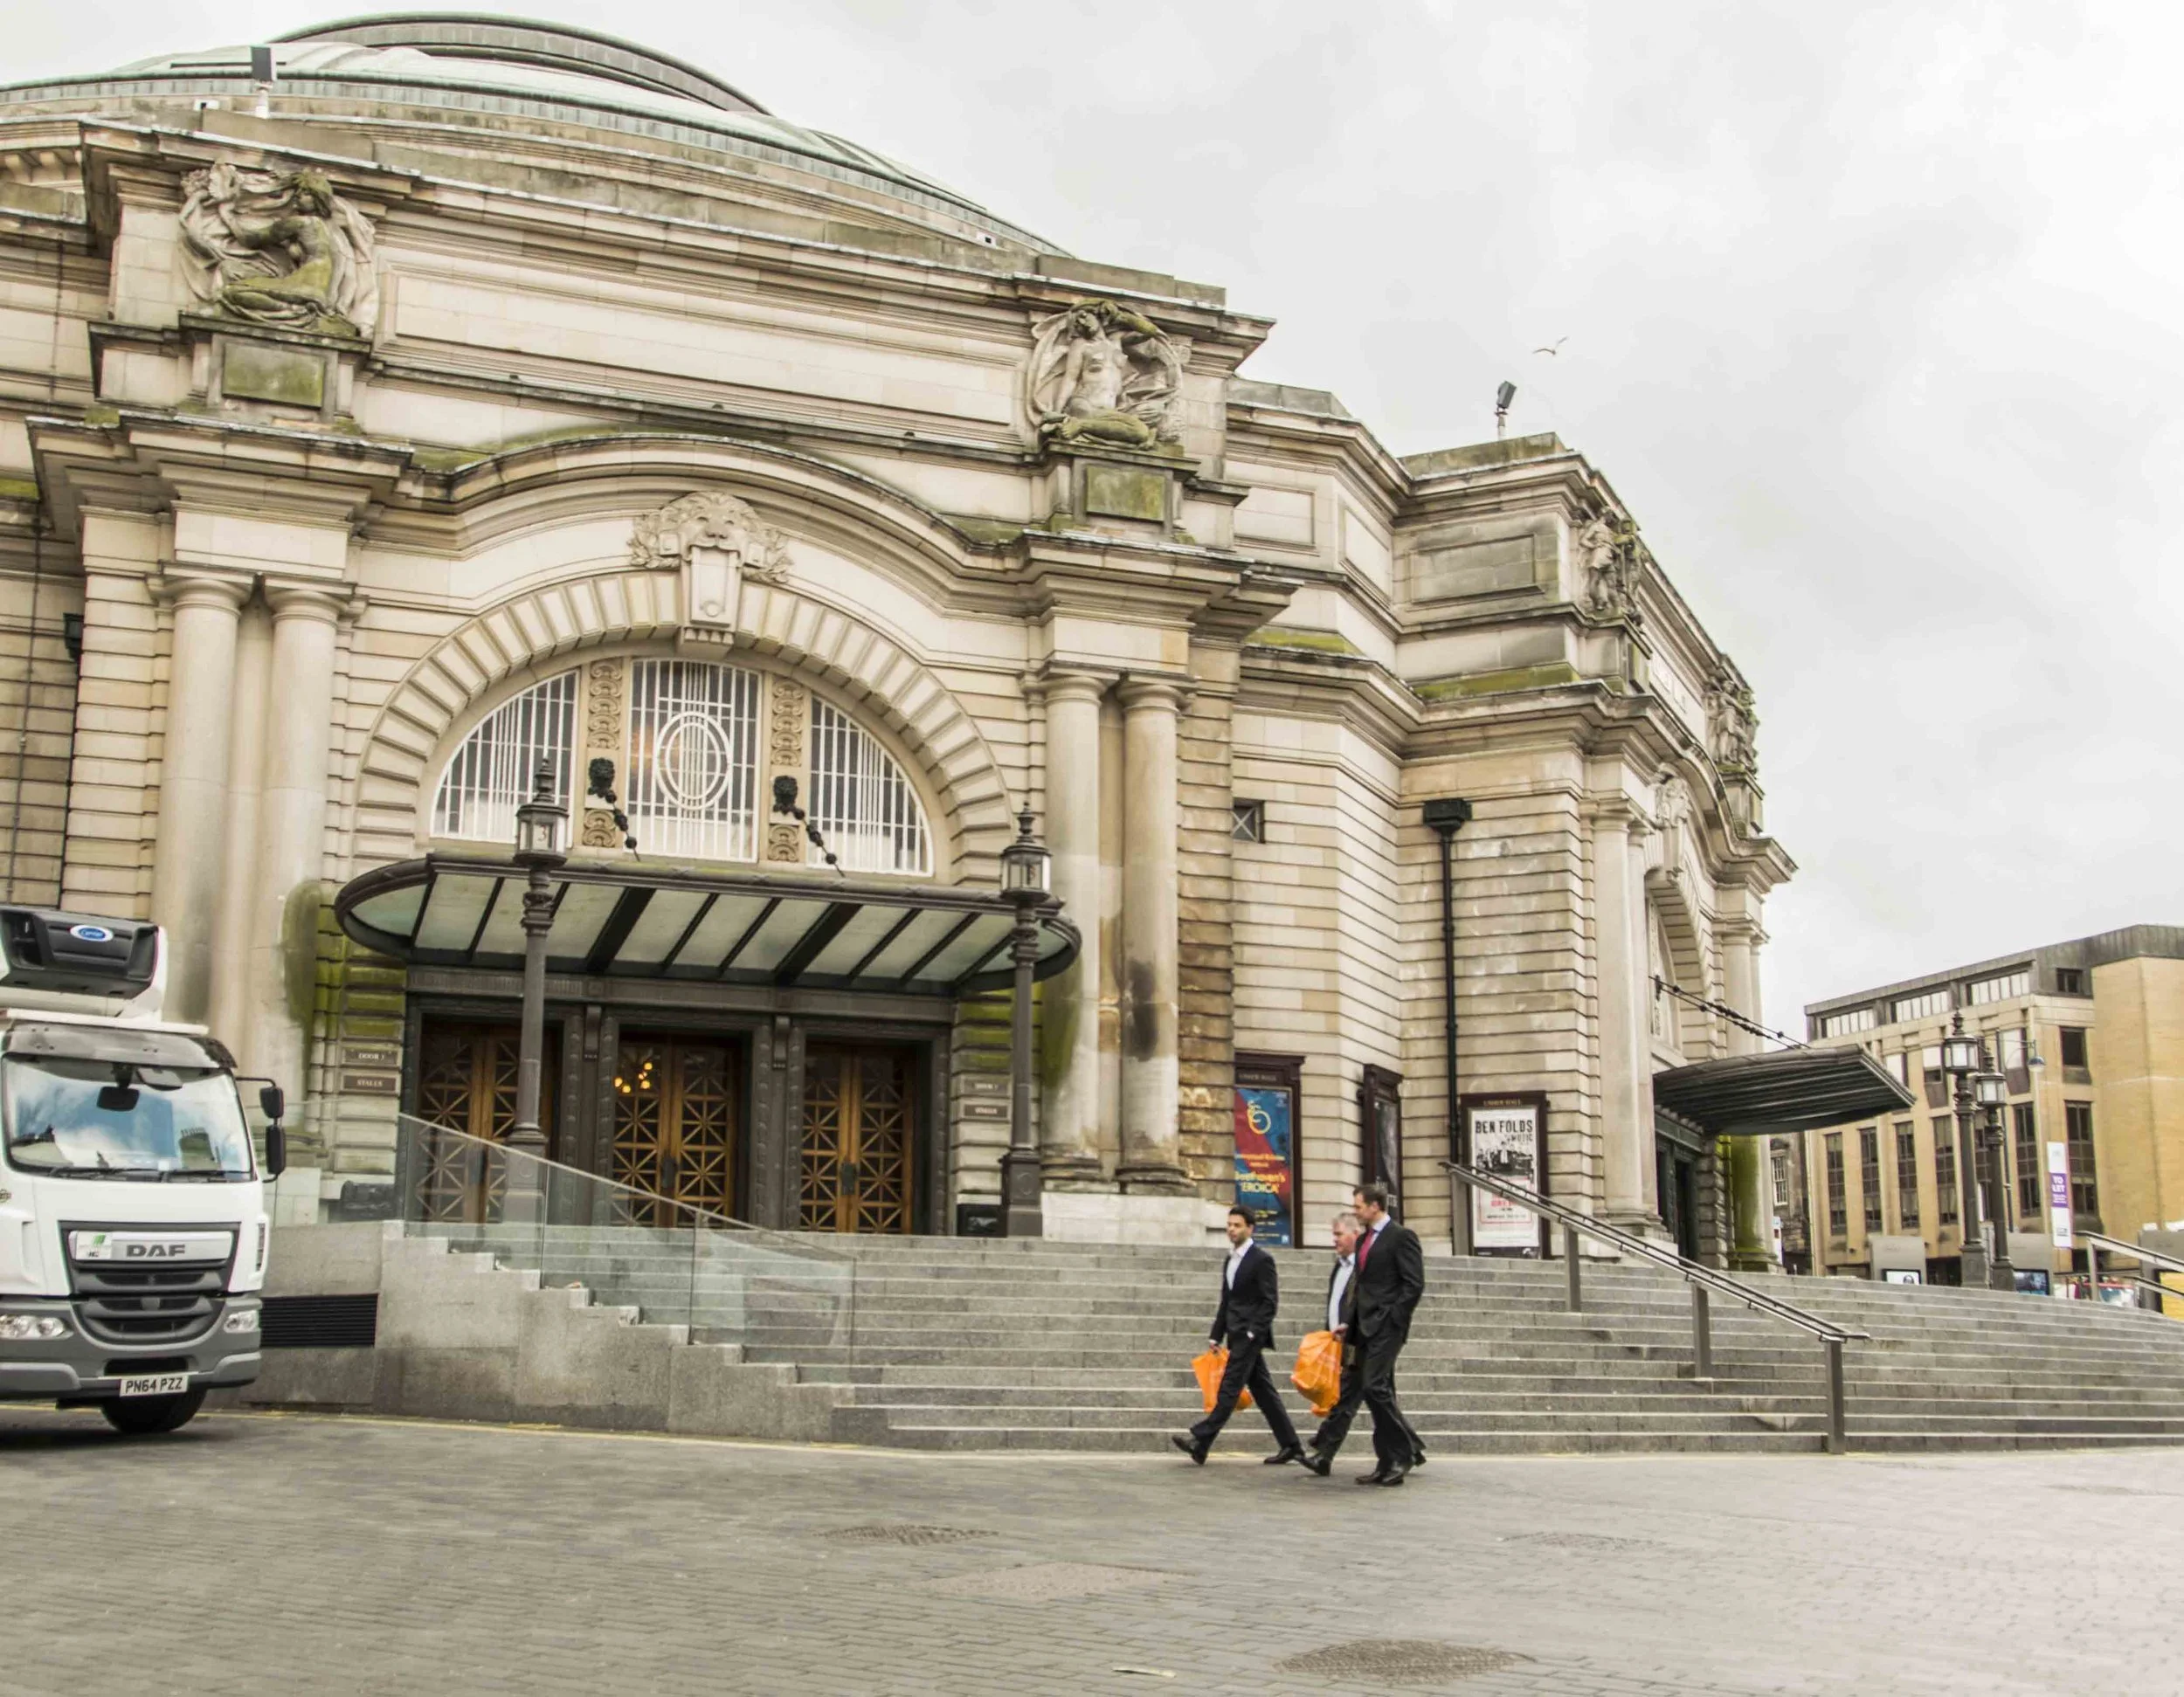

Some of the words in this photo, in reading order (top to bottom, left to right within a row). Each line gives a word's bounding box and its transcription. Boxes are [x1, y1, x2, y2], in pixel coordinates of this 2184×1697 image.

[1475, 1120, 1496, 1134] BEN
[1499, 1120, 1532, 1133] FOLDS
[126, 1244, 186, 1258] DAF
[125, 1378, 157, 1394] PN64
[160, 1376, 183, 1392] PZZ
